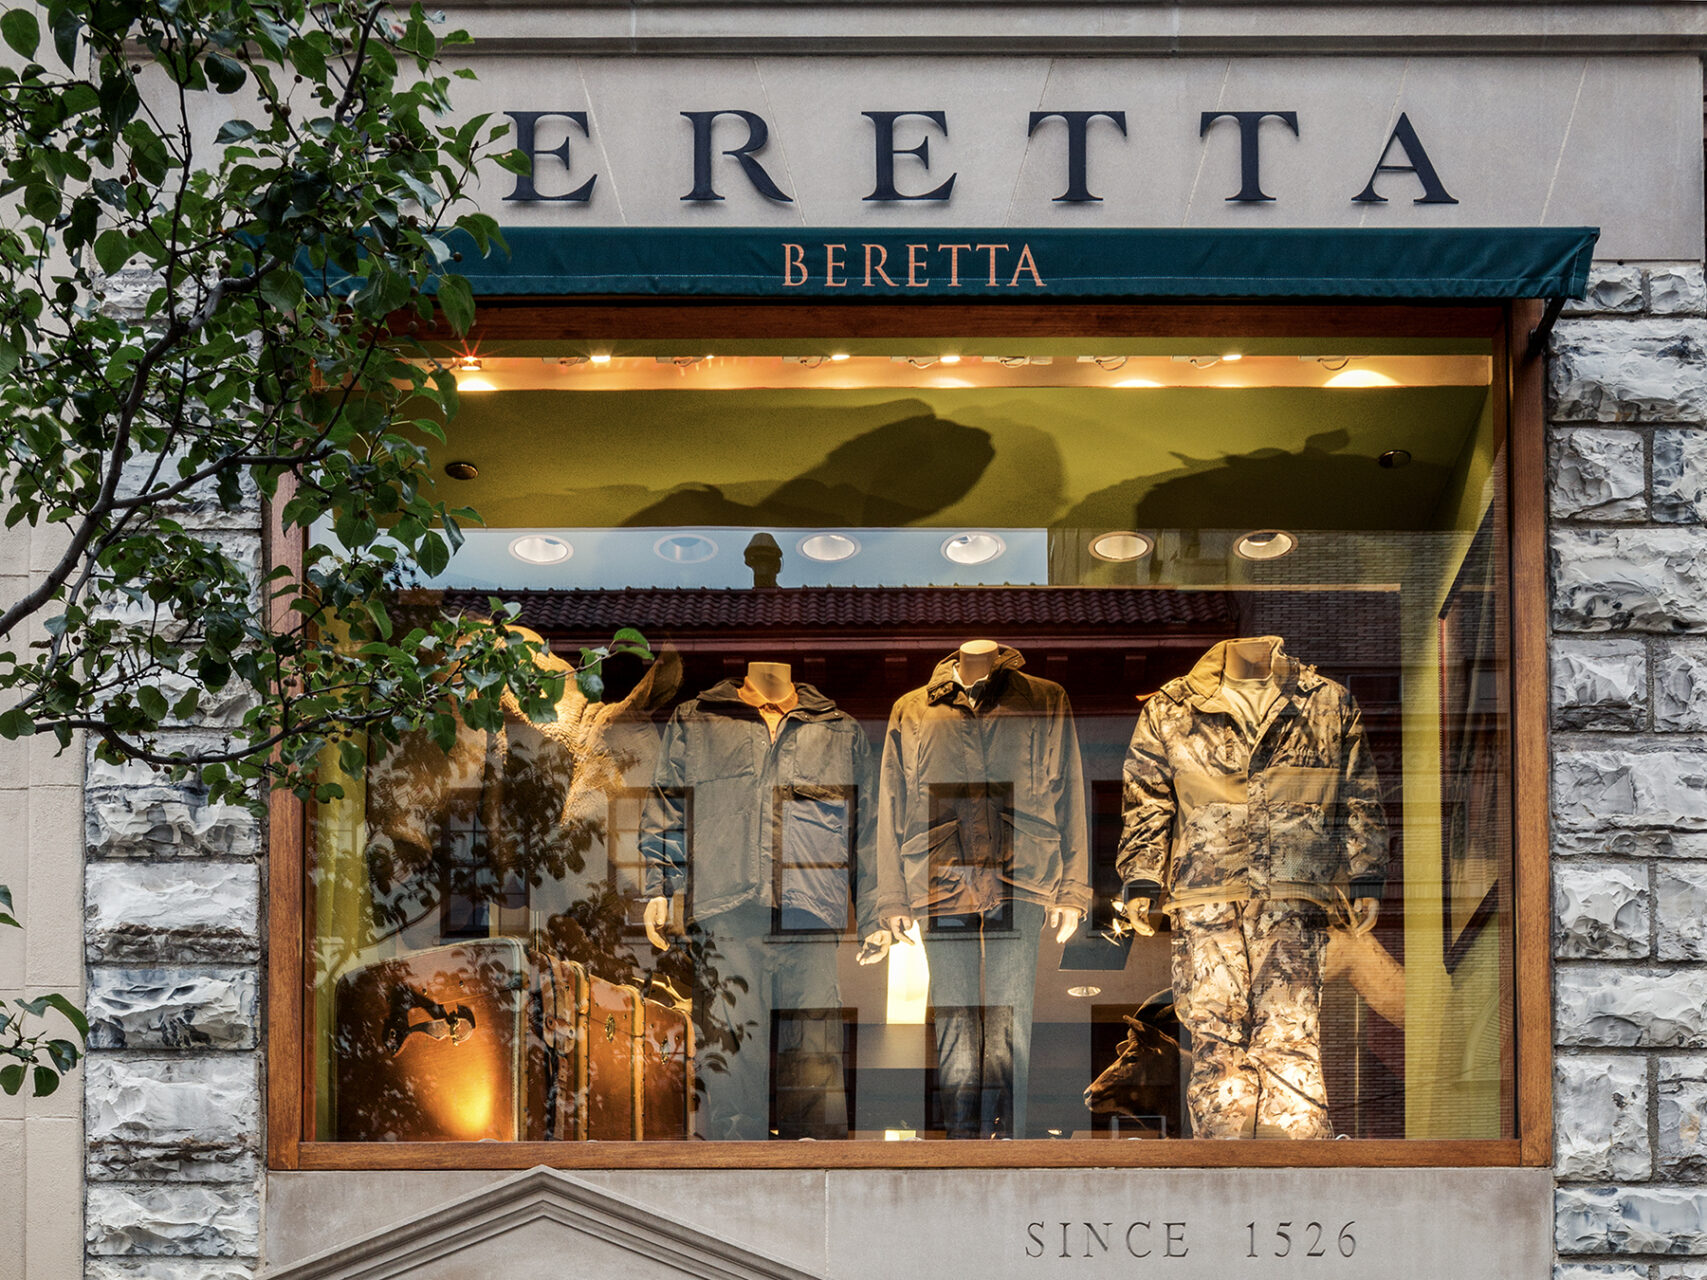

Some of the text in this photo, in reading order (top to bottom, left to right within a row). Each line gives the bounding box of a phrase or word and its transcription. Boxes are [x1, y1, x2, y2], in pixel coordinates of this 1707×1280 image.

[338, 110, 1460, 205] ERETTA
[781, 242, 1048, 288] BERETTA
[1025, 1220, 1357, 1259] SINCE 1526
